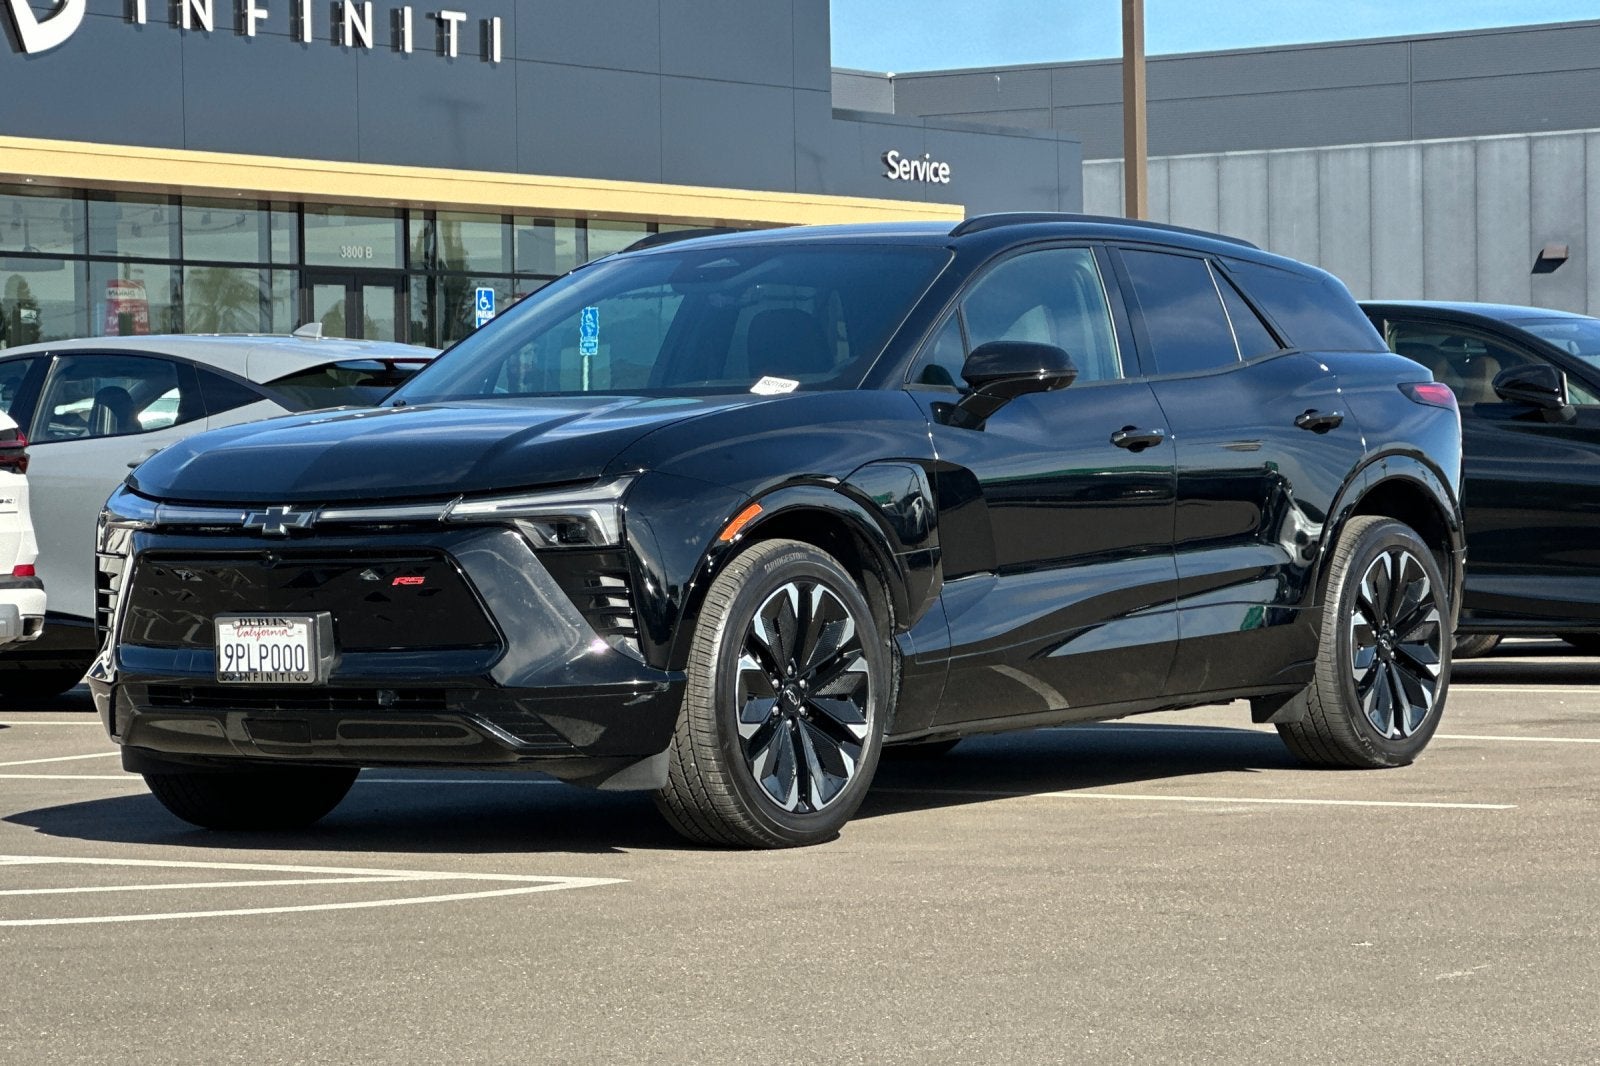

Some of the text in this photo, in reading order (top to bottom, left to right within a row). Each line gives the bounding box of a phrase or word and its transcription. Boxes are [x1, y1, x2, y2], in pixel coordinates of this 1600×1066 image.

[886, 149, 951, 184] Service
[341, 246, 373, 259] 3800 B
[764, 552, 808, 574] BRIDGESTONE
[391, 576, 426, 586] RS
[239, 618, 287, 627] DUBLIN
[236, 626, 294, 642] California
[224, 643, 305, 672] 9PLP000
